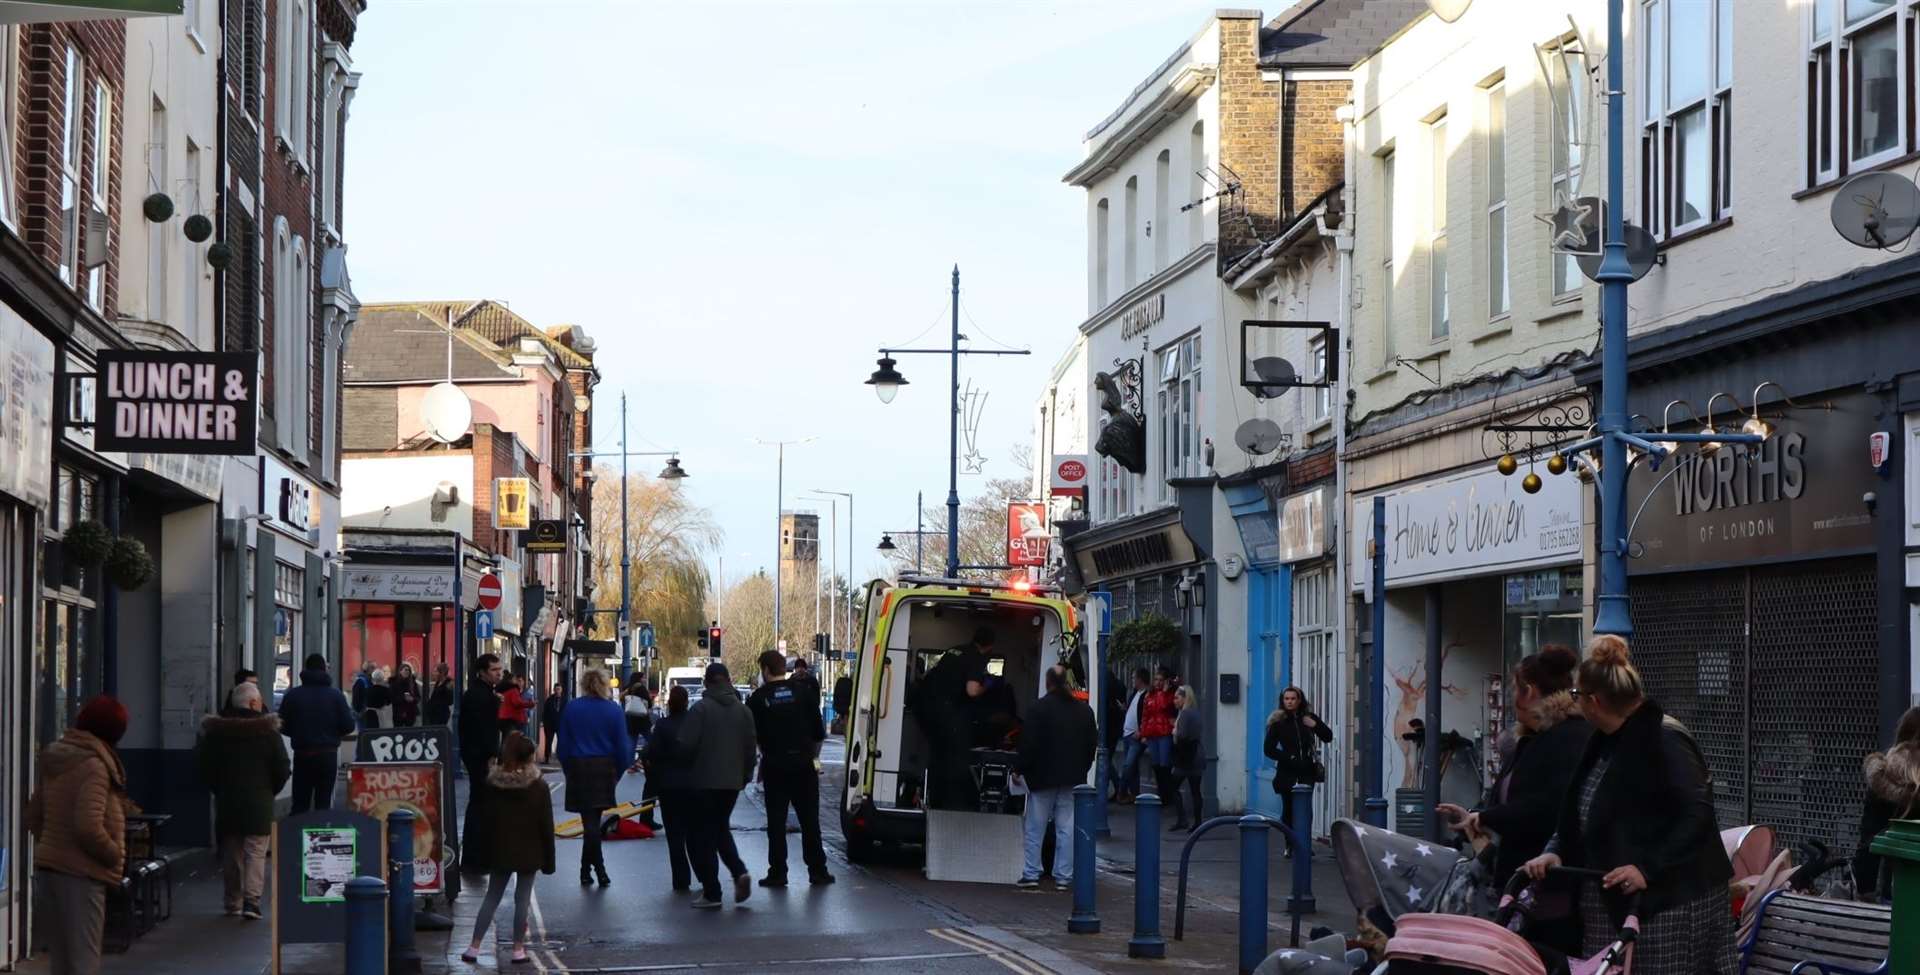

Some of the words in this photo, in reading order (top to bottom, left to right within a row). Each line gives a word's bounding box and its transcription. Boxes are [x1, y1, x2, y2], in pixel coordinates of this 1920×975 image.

[108, 362, 215, 399] LUNCH
[223, 370, 248, 400] &
[115, 401, 236, 440] DINNER
[1674, 432, 1804, 515] WORTHS
[1394, 504, 1440, 564] Home
[1447, 501, 1458, 554] &
[1466, 480, 1527, 552] Garden
[1701, 526, 1714, 543] OF
[1722, 519, 1774, 541] LONDON
[359, 788, 428, 808] DINNER
[364, 770, 419, 790] ROAST
